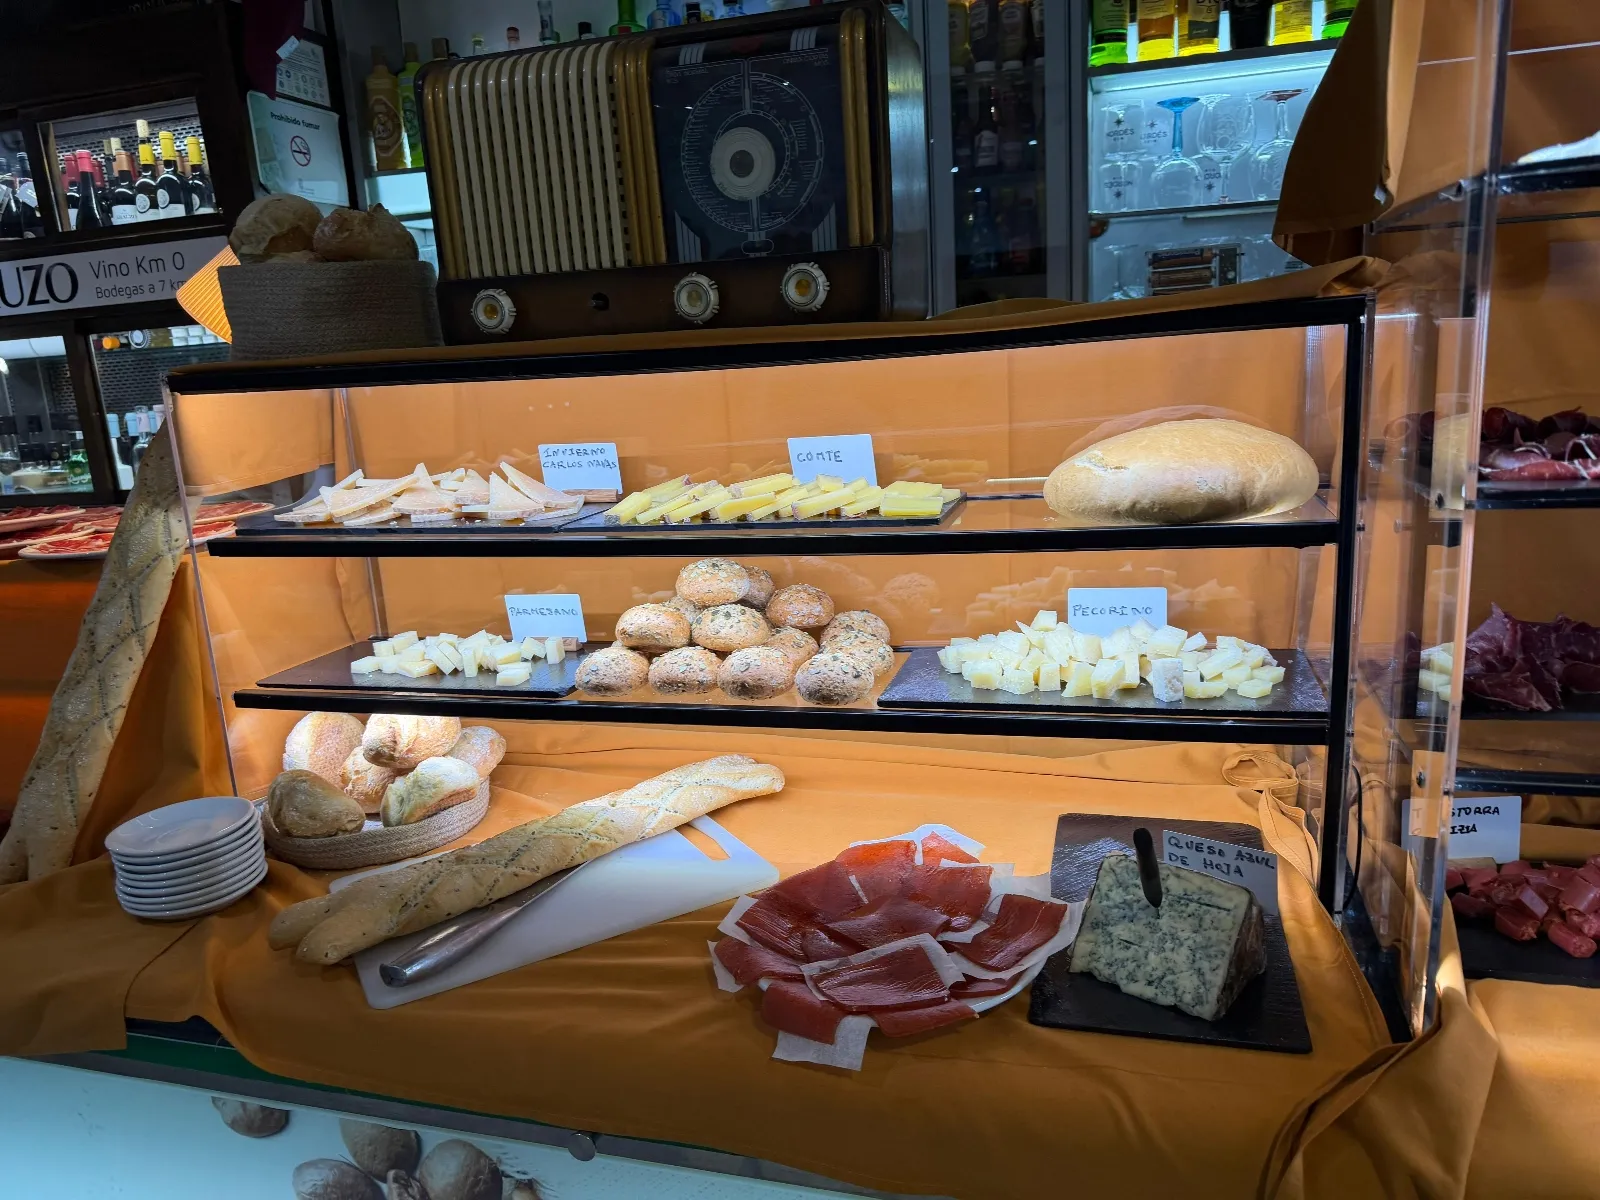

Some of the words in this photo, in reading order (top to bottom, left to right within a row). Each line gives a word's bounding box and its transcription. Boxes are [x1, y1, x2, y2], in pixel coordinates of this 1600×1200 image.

[270, 111, 301, 126] Prohibido
[302, 119, 320, 130] fumar
[89, 261, 130, 280] Vino
[135, 256, 166, 275] Km
[0, 262, 79, 309] UZO
[96, 284, 145, 299] Bodegas
[149, 285, 155, 294] a
[159, 280, 165, 293] 7
[543, 447, 606, 458] INVIERNO
[796, 450, 843, 462] COMTE
[542, 460, 583, 469] CARLOS
[508, 606, 579, 616] PARMESANO
[1072, 604, 1153, 617] PECORINO
[1167, 836, 1226, 857] QUESO
[1234, 849, 1275, 869] AZUL
[1168, 852, 1190, 866] DE
[1202, 857, 1244, 878] HOJA
